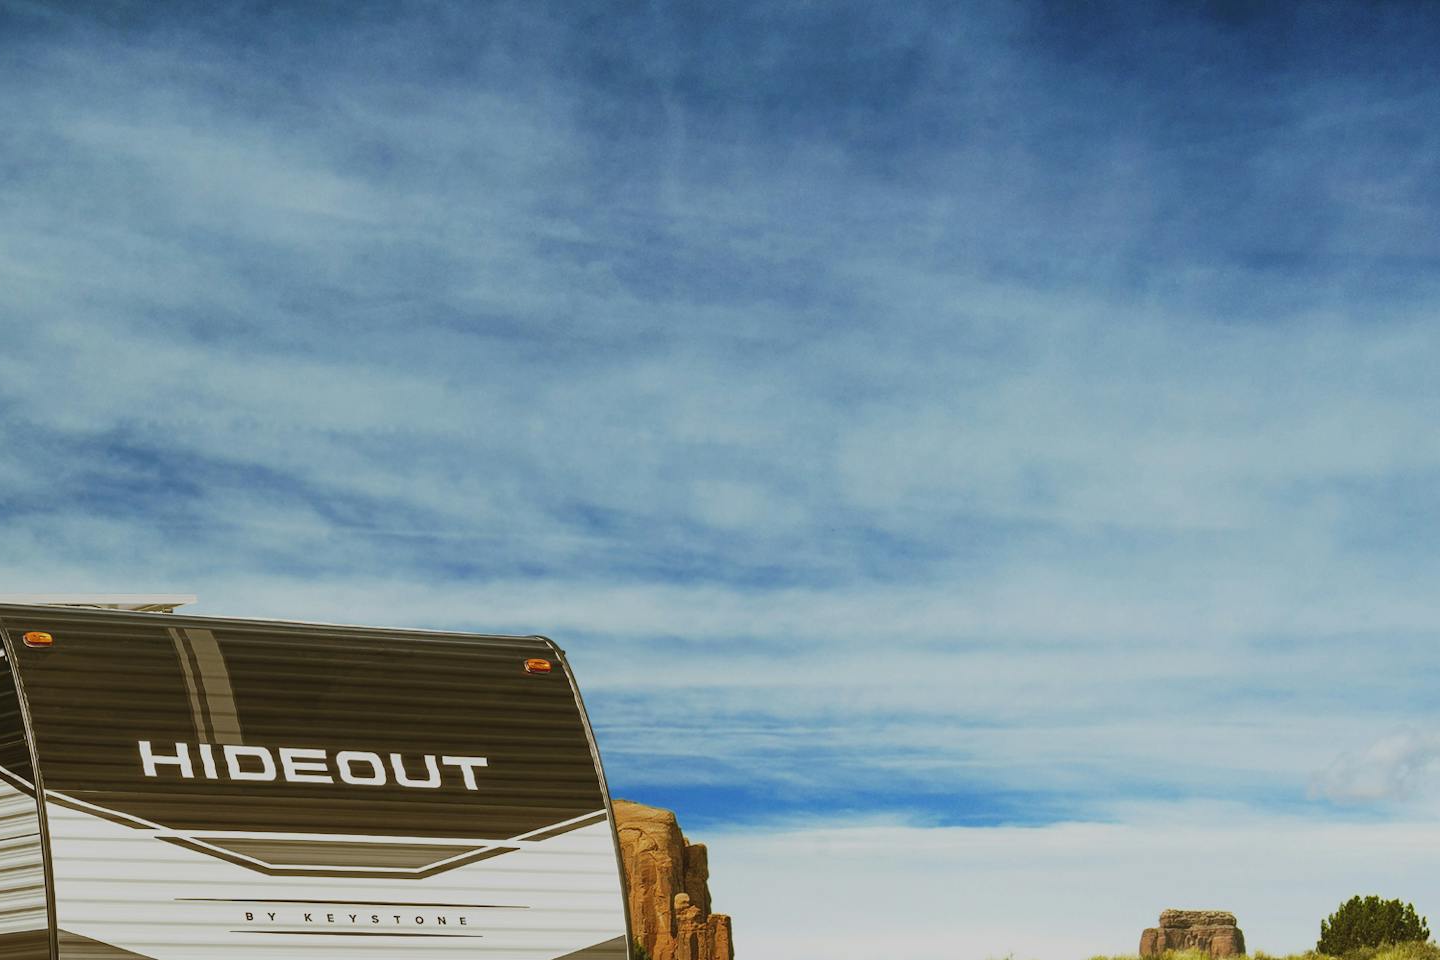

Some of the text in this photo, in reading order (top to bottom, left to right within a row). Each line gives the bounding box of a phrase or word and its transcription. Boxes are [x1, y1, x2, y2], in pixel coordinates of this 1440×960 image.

[138, 740, 488, 791] HIDEOUT
[245, 912, 467, 925] BY KEYSTONE
